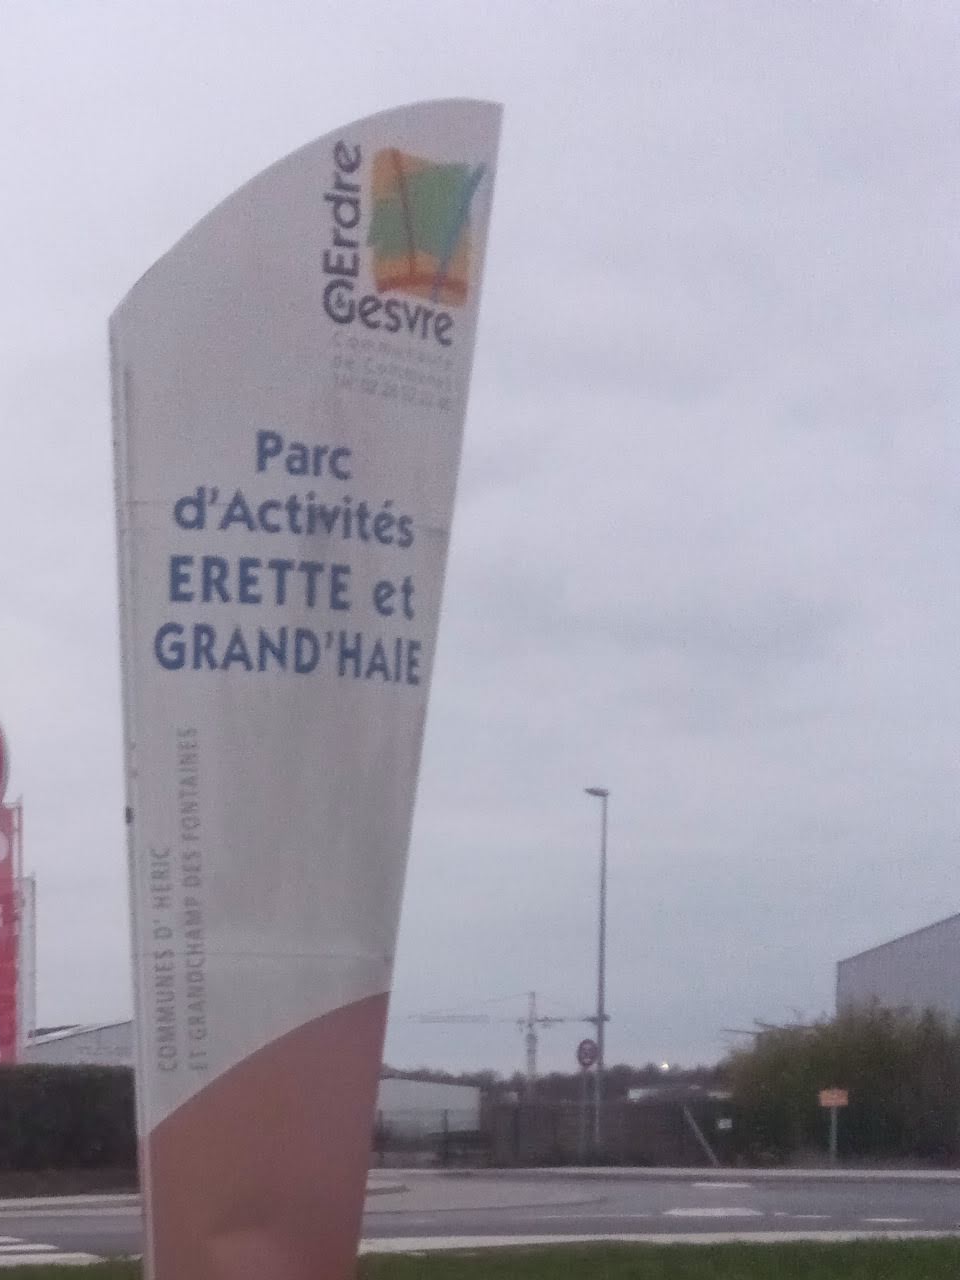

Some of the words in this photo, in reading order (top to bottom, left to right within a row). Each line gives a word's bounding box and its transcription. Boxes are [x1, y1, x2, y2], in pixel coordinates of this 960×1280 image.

[323, 140, 362, 277] Erdre
[323, 279, 455, 347] Gesvre
[256, 430, 352, 480] Parc
[173, 486, 415, 548] d'Activités
[168, 555, 351, 611] ERETTE
[373, 576, 415, 621] et
[154, 621, 423, 686] GRAND'HAIE
[182, 850, 202, 888] DES
[154, 949, 177, 1072] COMMUNES
